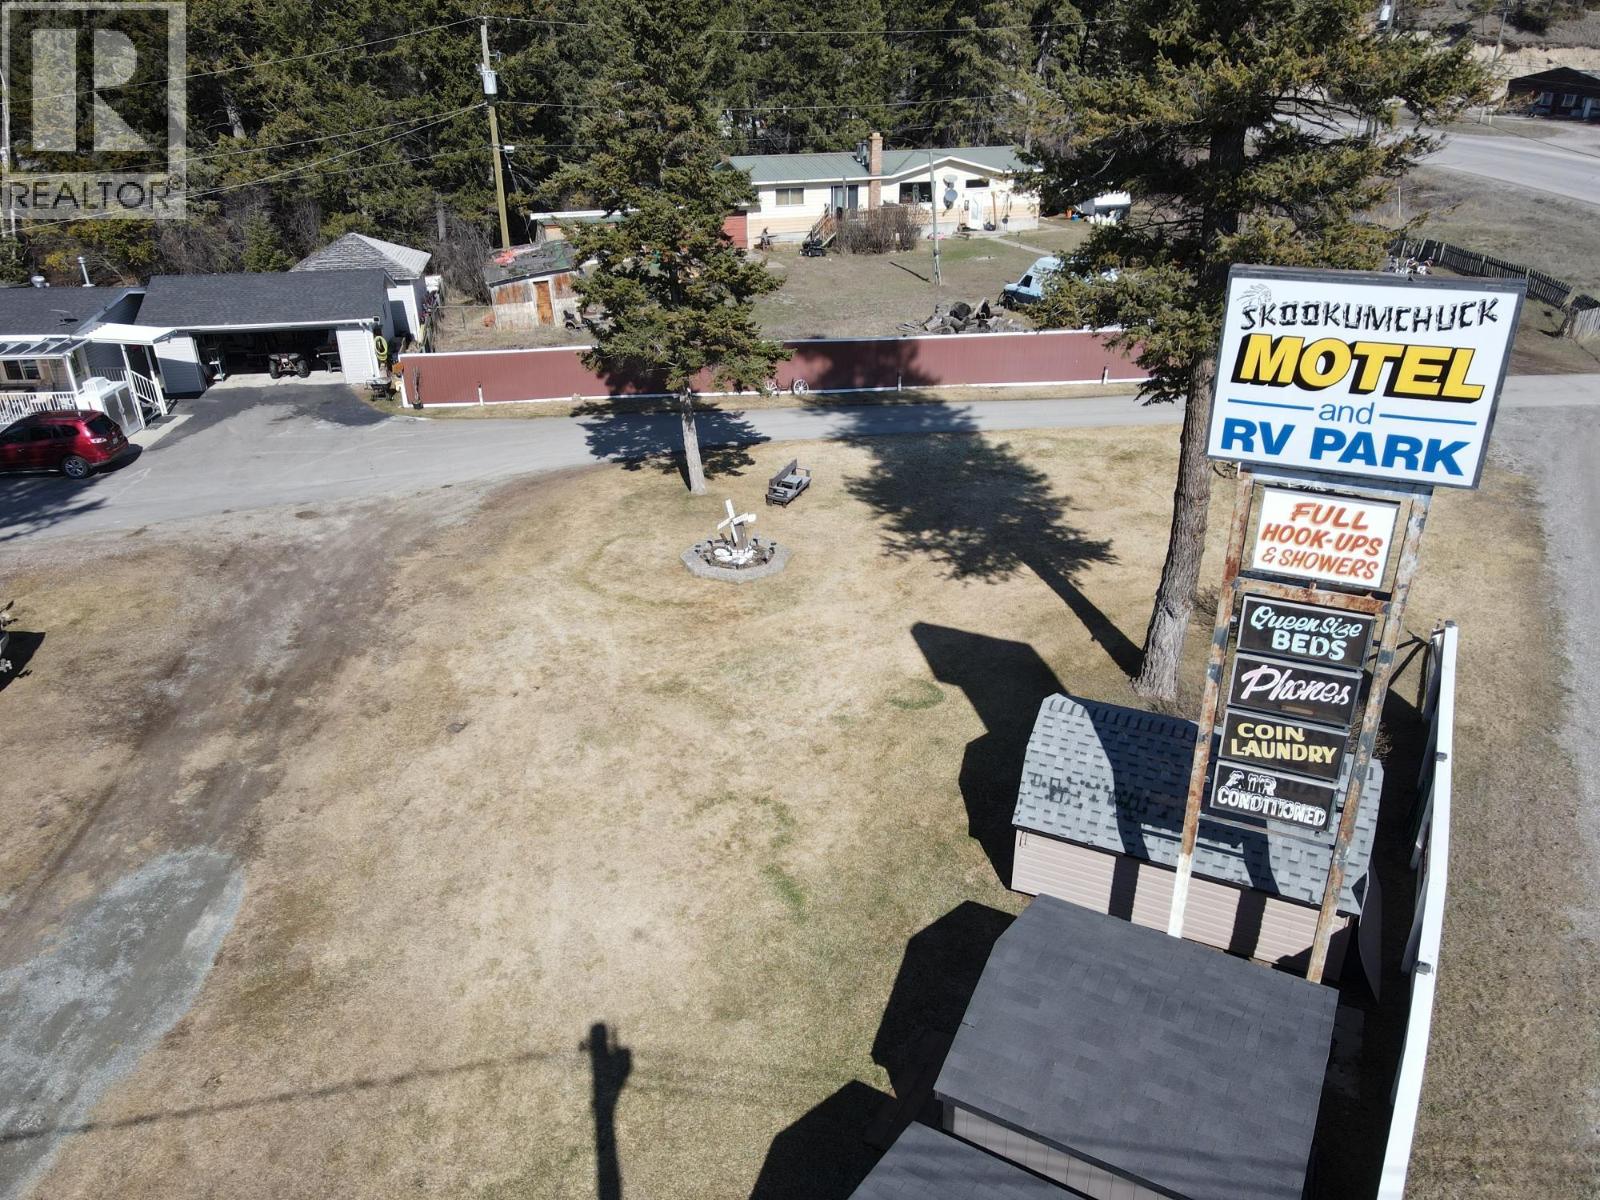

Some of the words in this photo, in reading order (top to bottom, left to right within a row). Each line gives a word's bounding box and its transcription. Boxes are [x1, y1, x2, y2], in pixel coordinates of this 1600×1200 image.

[1241, 299, 1499, 332] SKOOKUMCHUCK
[1231, 333, 1485, 403] MOTEL
[1318, 403, 1375, 425] and
[1220, 417, 1296, 455] RV
[1309, 427, 1471, 476] PARK
[1291, 502, 1369, 531] FULL
[1261, 523, 1383, 556] HOOK-UPS
[1262, 547, 1277, 563] &
[1279, 549, 1380, 580] SHOWERS
[1271, 630, 1348, 661] BEDS
[1241, 664, 1352, 705] Phones
[1237, 722, 1305, 742] COIN
[1231, 739, 1338, 764] LAUNDRY
[1217, 786, 1327, 827] CONDITIONED
